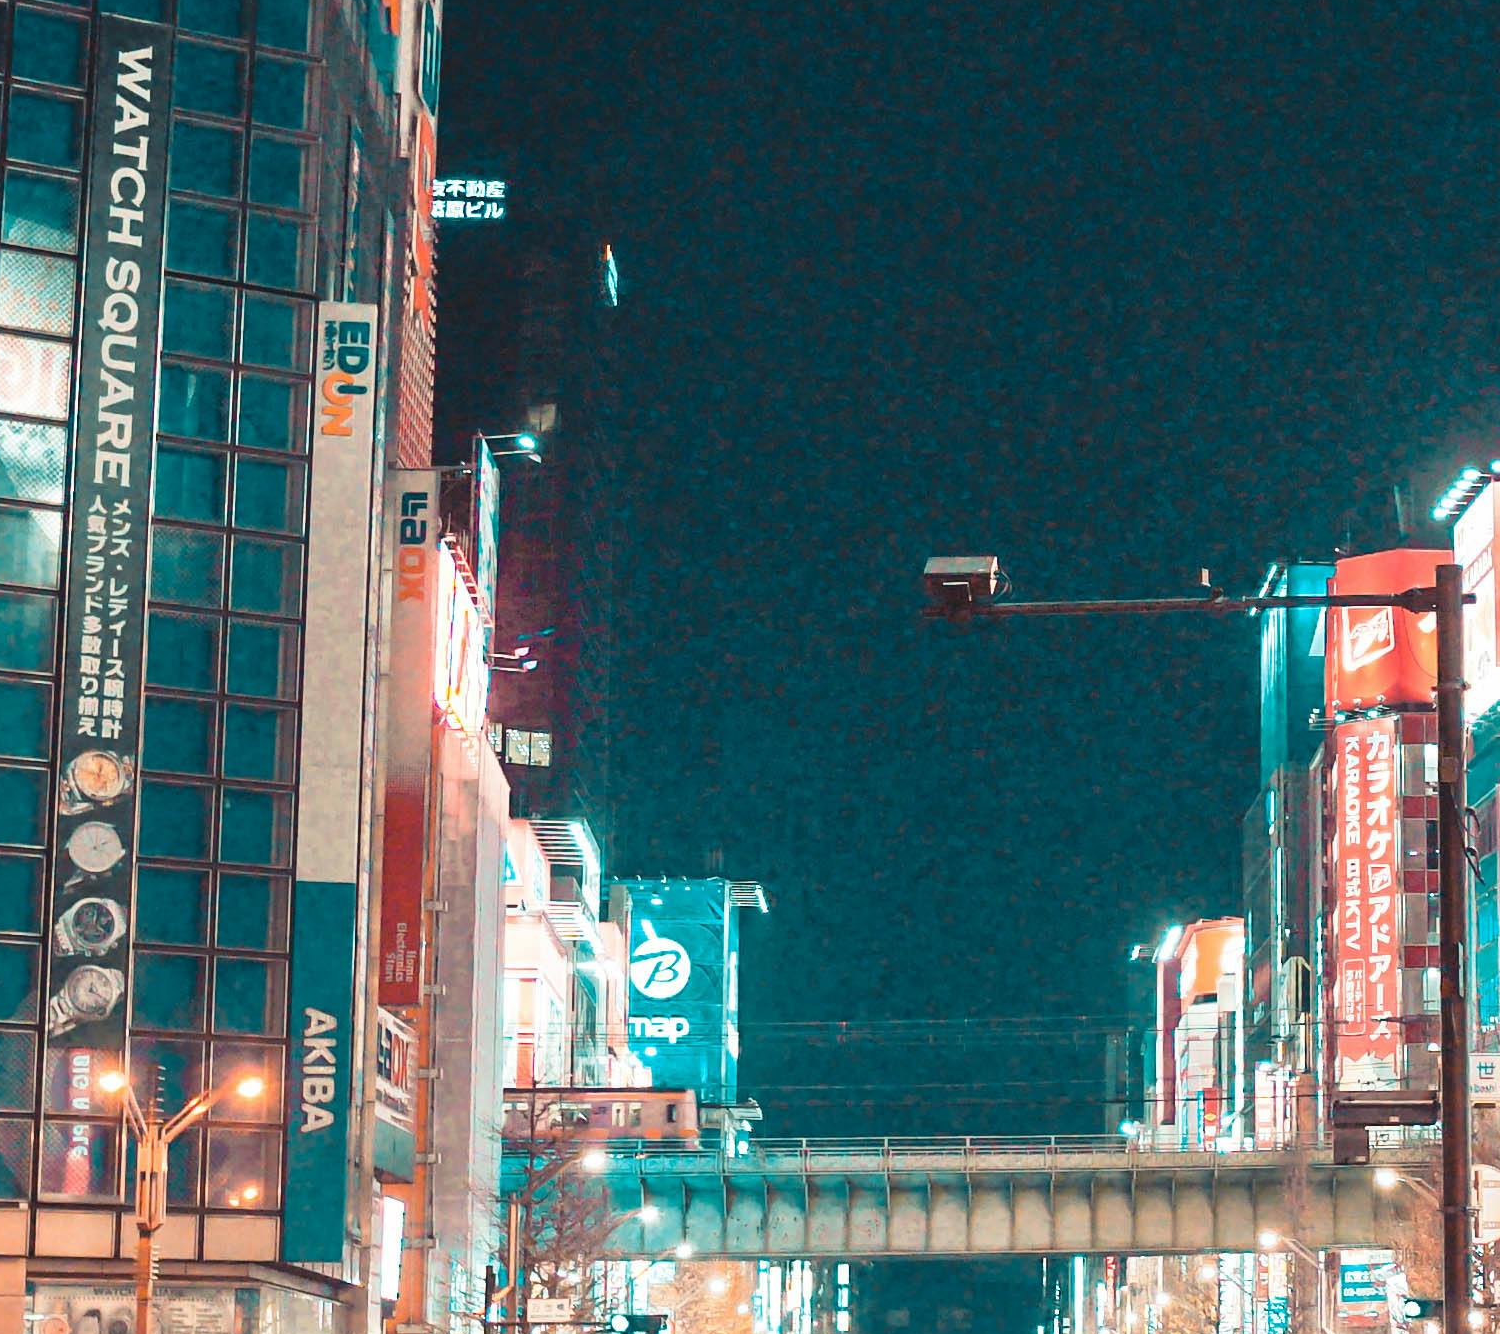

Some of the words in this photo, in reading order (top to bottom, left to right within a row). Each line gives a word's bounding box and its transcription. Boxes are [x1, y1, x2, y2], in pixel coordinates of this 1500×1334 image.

[106, 46, 153, 247] WATCH
[91, 256, 141, 488] SQUARE
[321, 321, 371, 437] EDION
[101, 498, 132, 740] メンズ・レディース腕時計
[1344, 736, 1361, 846] KARAOKE
[1366, 730, 1392, 860] カラオケ
[395, 922, 408, 983] Electronics
[299, 1007, 338, 1134] AKIBA
